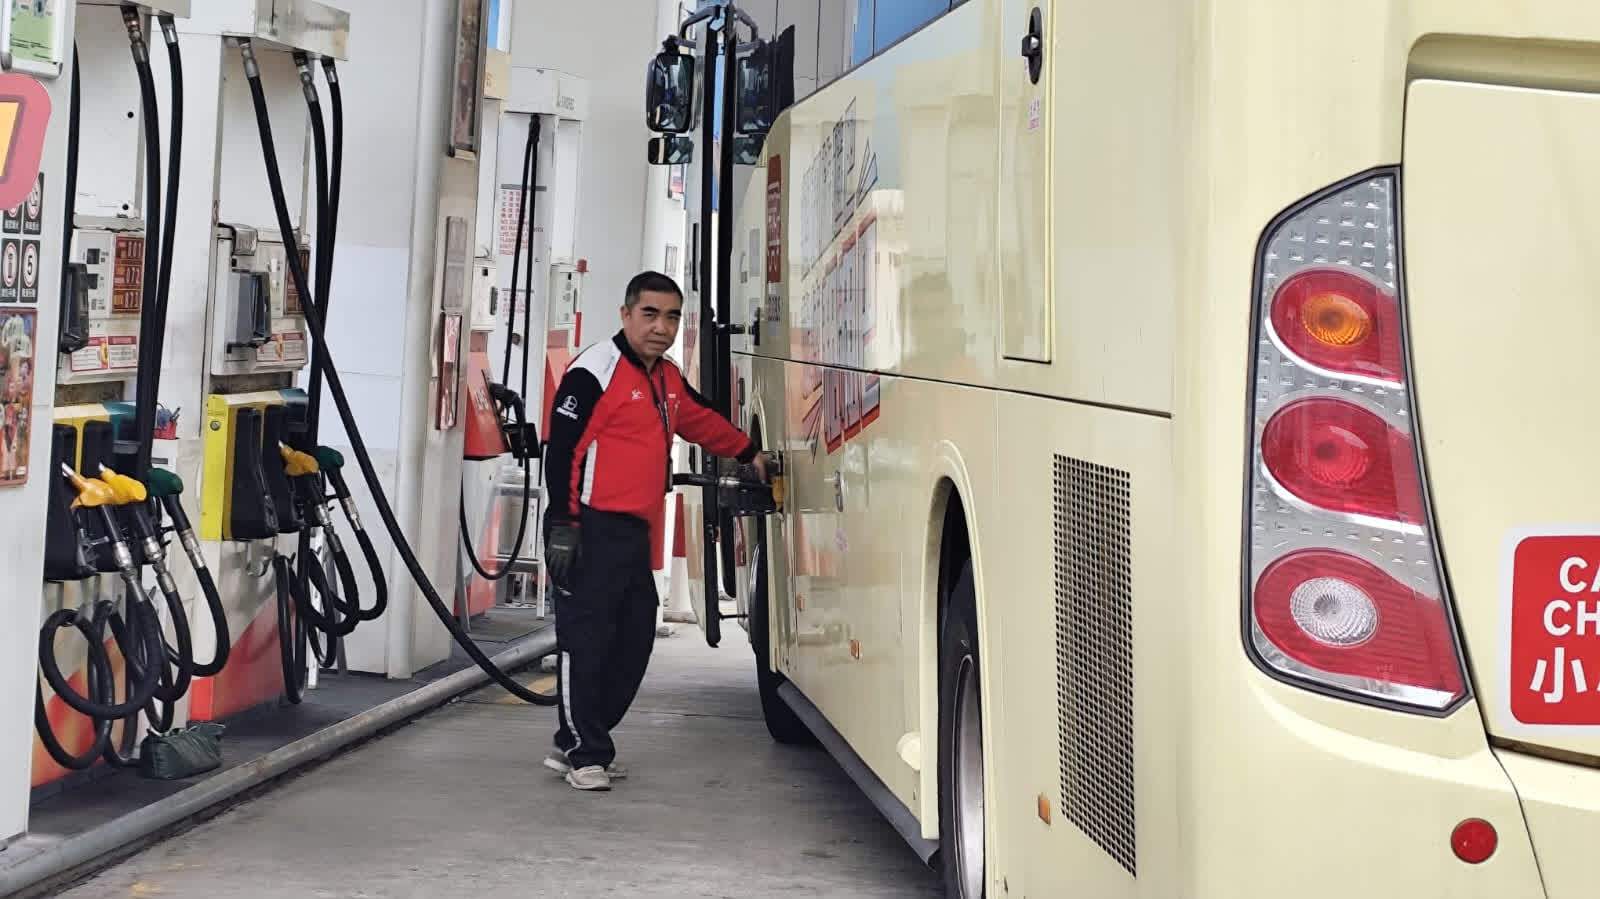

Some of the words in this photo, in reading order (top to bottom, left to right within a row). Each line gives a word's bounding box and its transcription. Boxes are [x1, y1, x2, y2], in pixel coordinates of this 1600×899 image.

[27, 255, 33, 275] 5
[1559, 557, 1600, 593] C
[1543, 599, 1600, 636] CH
[1530, 646, 1600, 703] 小
